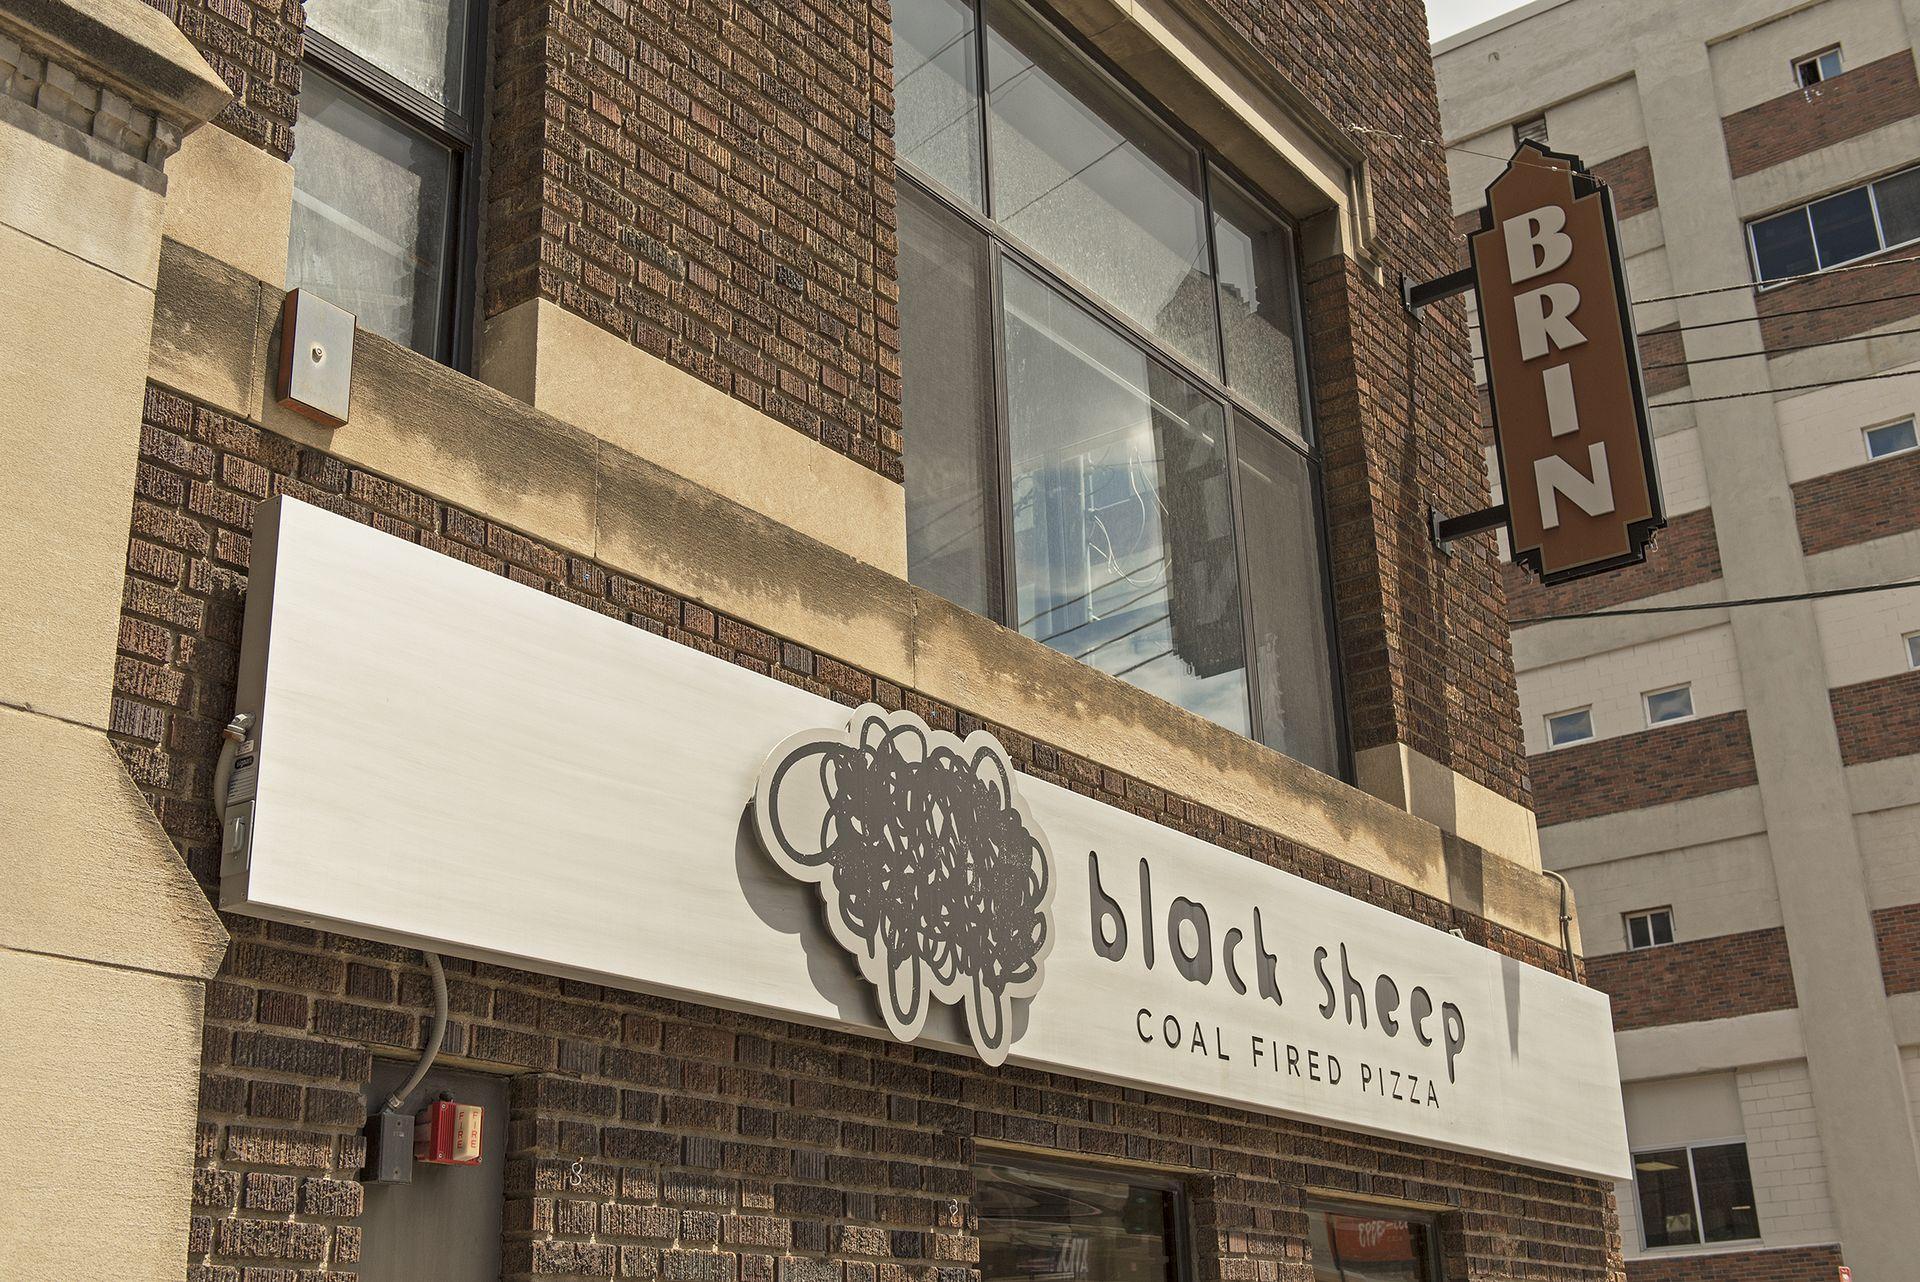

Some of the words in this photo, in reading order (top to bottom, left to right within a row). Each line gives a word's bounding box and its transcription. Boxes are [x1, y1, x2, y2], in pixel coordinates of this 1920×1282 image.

[1502, 205, 1615, 529] BRIN
[1088, 850, 1283, 1007] black
[1313, 942, 1465, 1085] sheep
[1136, 1008, 1230, 1061] COAL
[1251, 1035, 1342, 1086] FIRED
[1360, 1062, 1440, 1109] PIZZA
[457, 1111, 465, 1149] FIRE
[470, 1111, 479, 1149] FIRE
